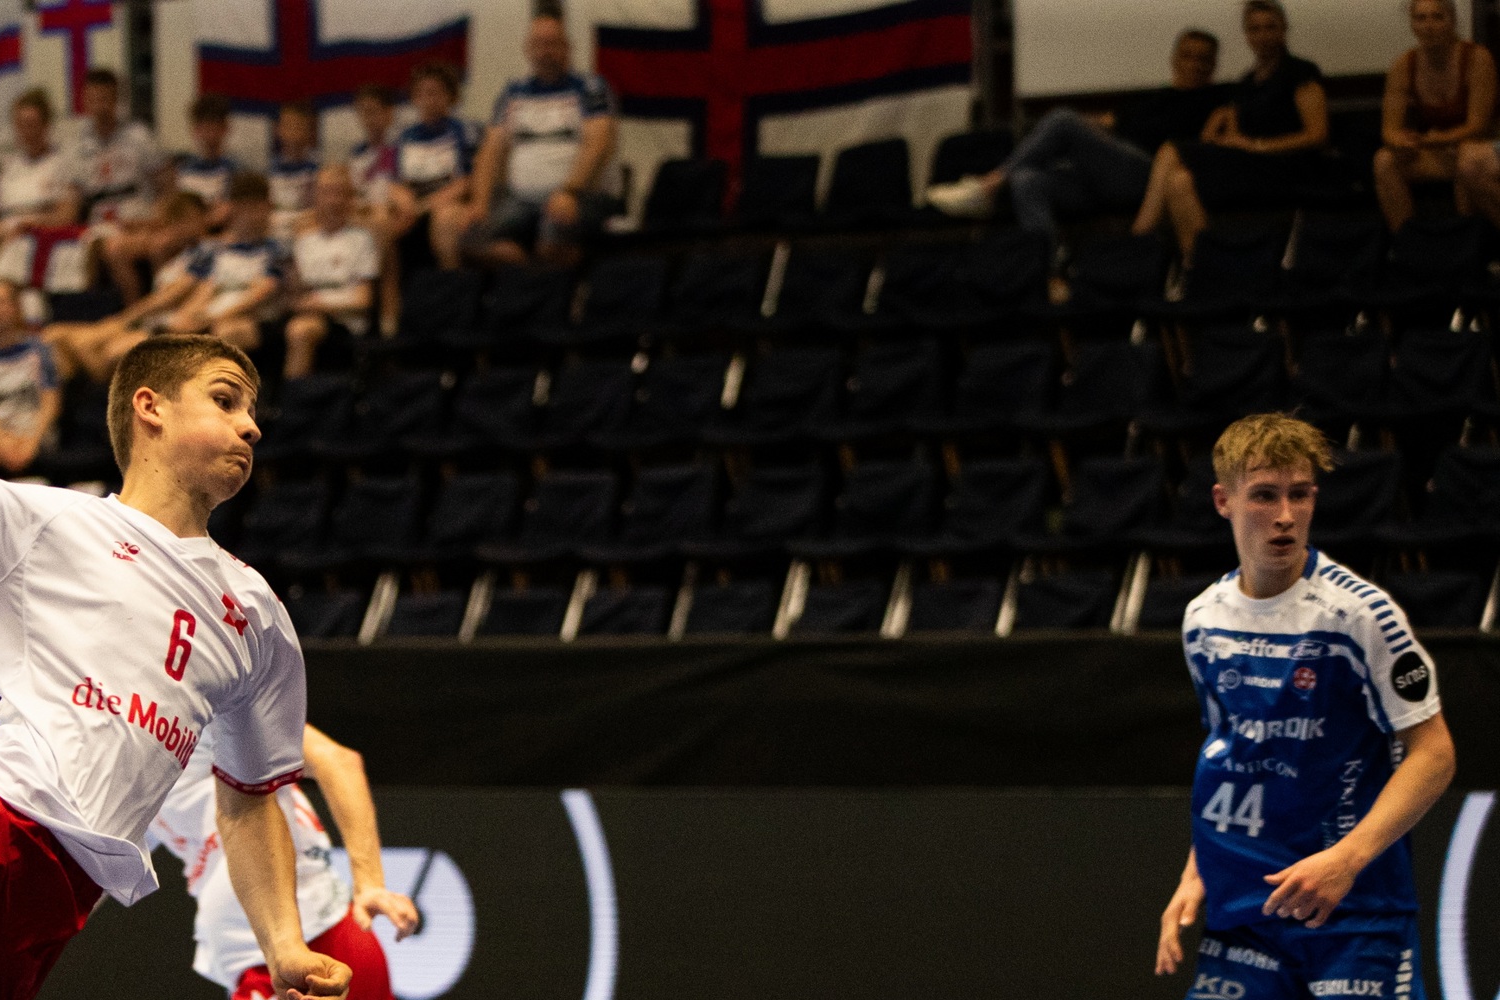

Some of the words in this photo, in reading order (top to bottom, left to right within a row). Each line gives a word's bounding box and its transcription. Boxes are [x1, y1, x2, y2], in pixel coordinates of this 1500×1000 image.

[164, 608, 197, 682] 6
[1395, 663, 1430, 691] sms
[71, 677, 122, 715] die
[127, 692, 197, 770] Mobili
[1201, 781, 1265, 838] 44
